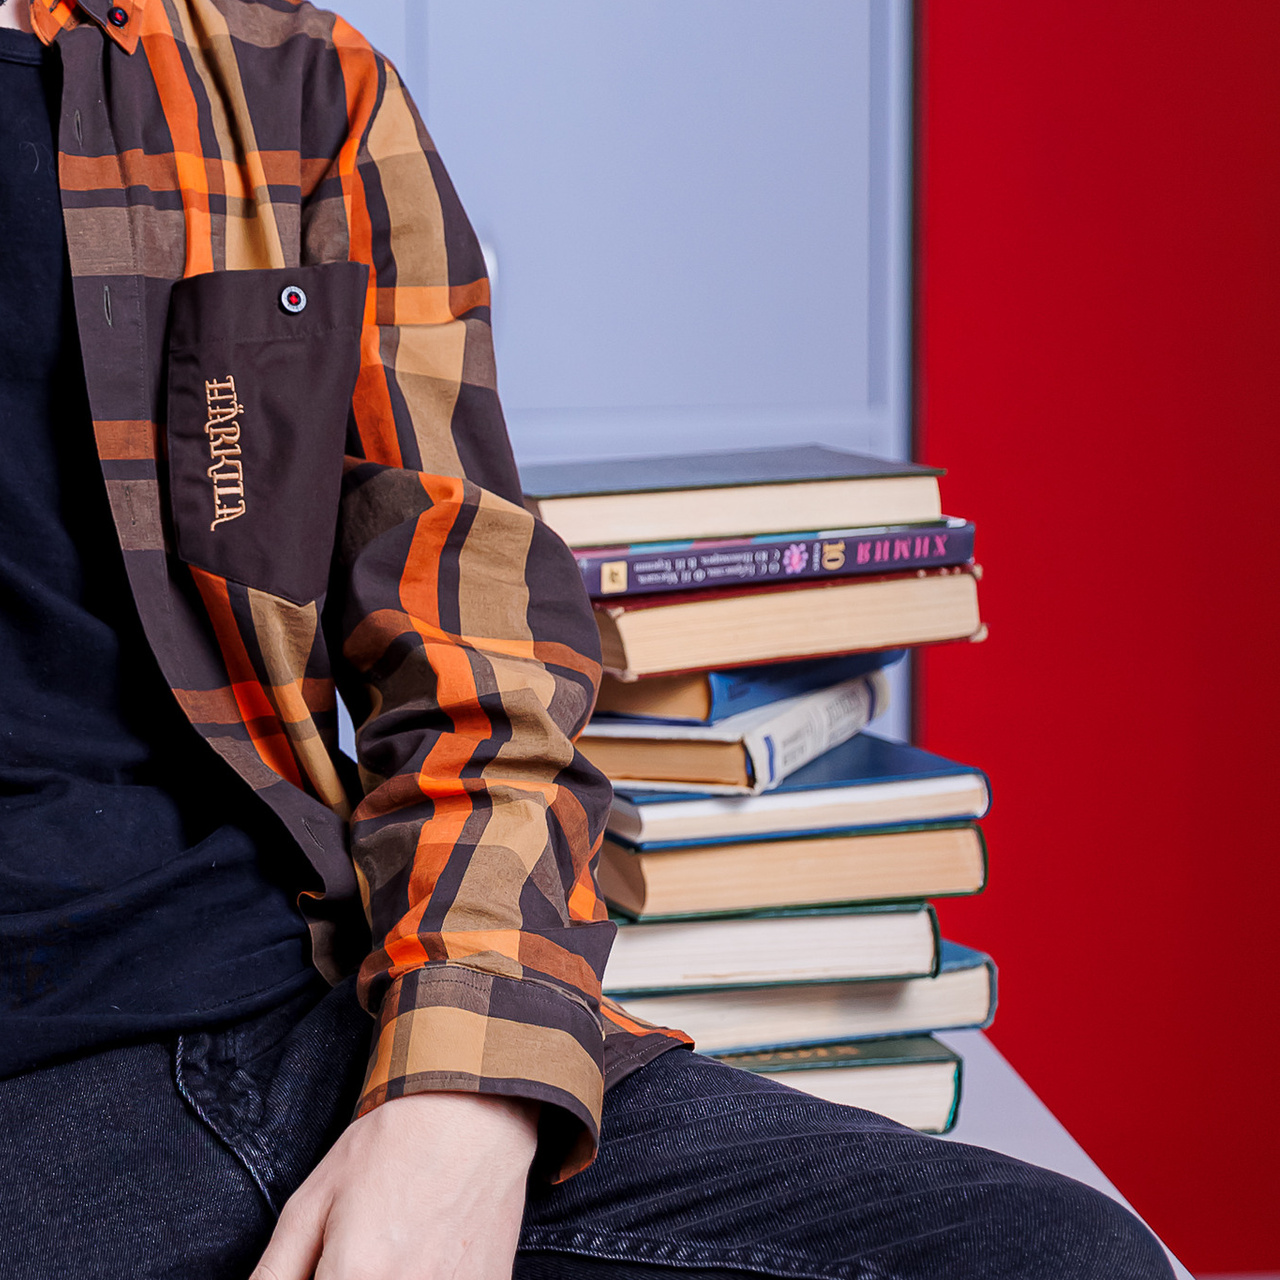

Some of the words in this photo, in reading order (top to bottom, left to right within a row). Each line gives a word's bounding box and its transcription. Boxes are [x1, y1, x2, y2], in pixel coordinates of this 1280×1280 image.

[205, 375, 245, 532] HÄRKILA
[822, 540, 846, 570] 10
[858, 535, 948, 564] ХИМИЯ
